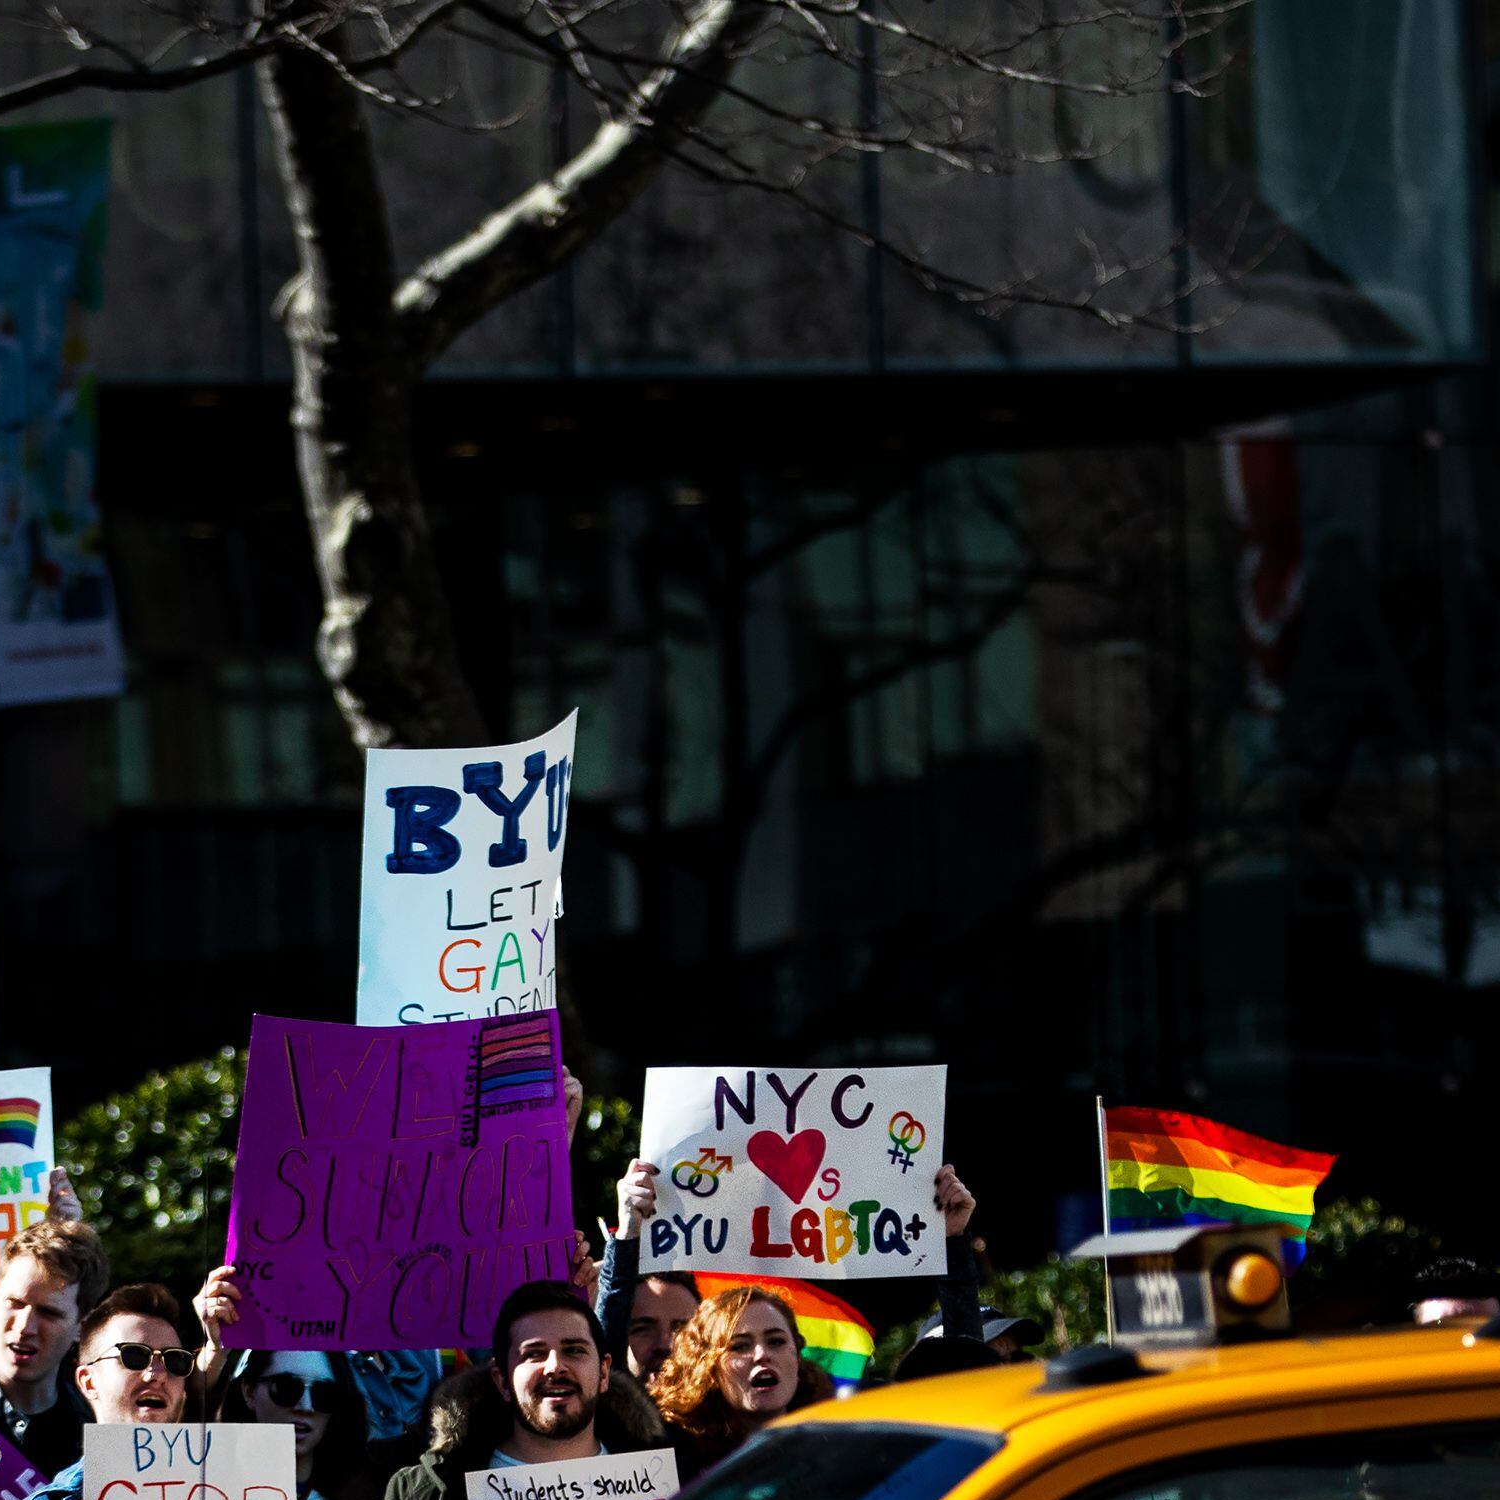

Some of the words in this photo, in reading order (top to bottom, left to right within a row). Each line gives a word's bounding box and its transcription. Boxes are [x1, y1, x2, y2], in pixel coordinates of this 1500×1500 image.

[386, 750, 571, 874] BYU
[446, 880, 542, 931] LET
[438, 918, 550, 994] GAY
[714, 1071, 874, 1134] NYC
[650, 1214, 729, 1258] BYU
[750, 1200, 927, 1264] LGBTQ+
[290, 1320, 336, 1338] UTAH
[134, 1427, 211, 1472] BYU
[593, 1468, 655, 1497] should
